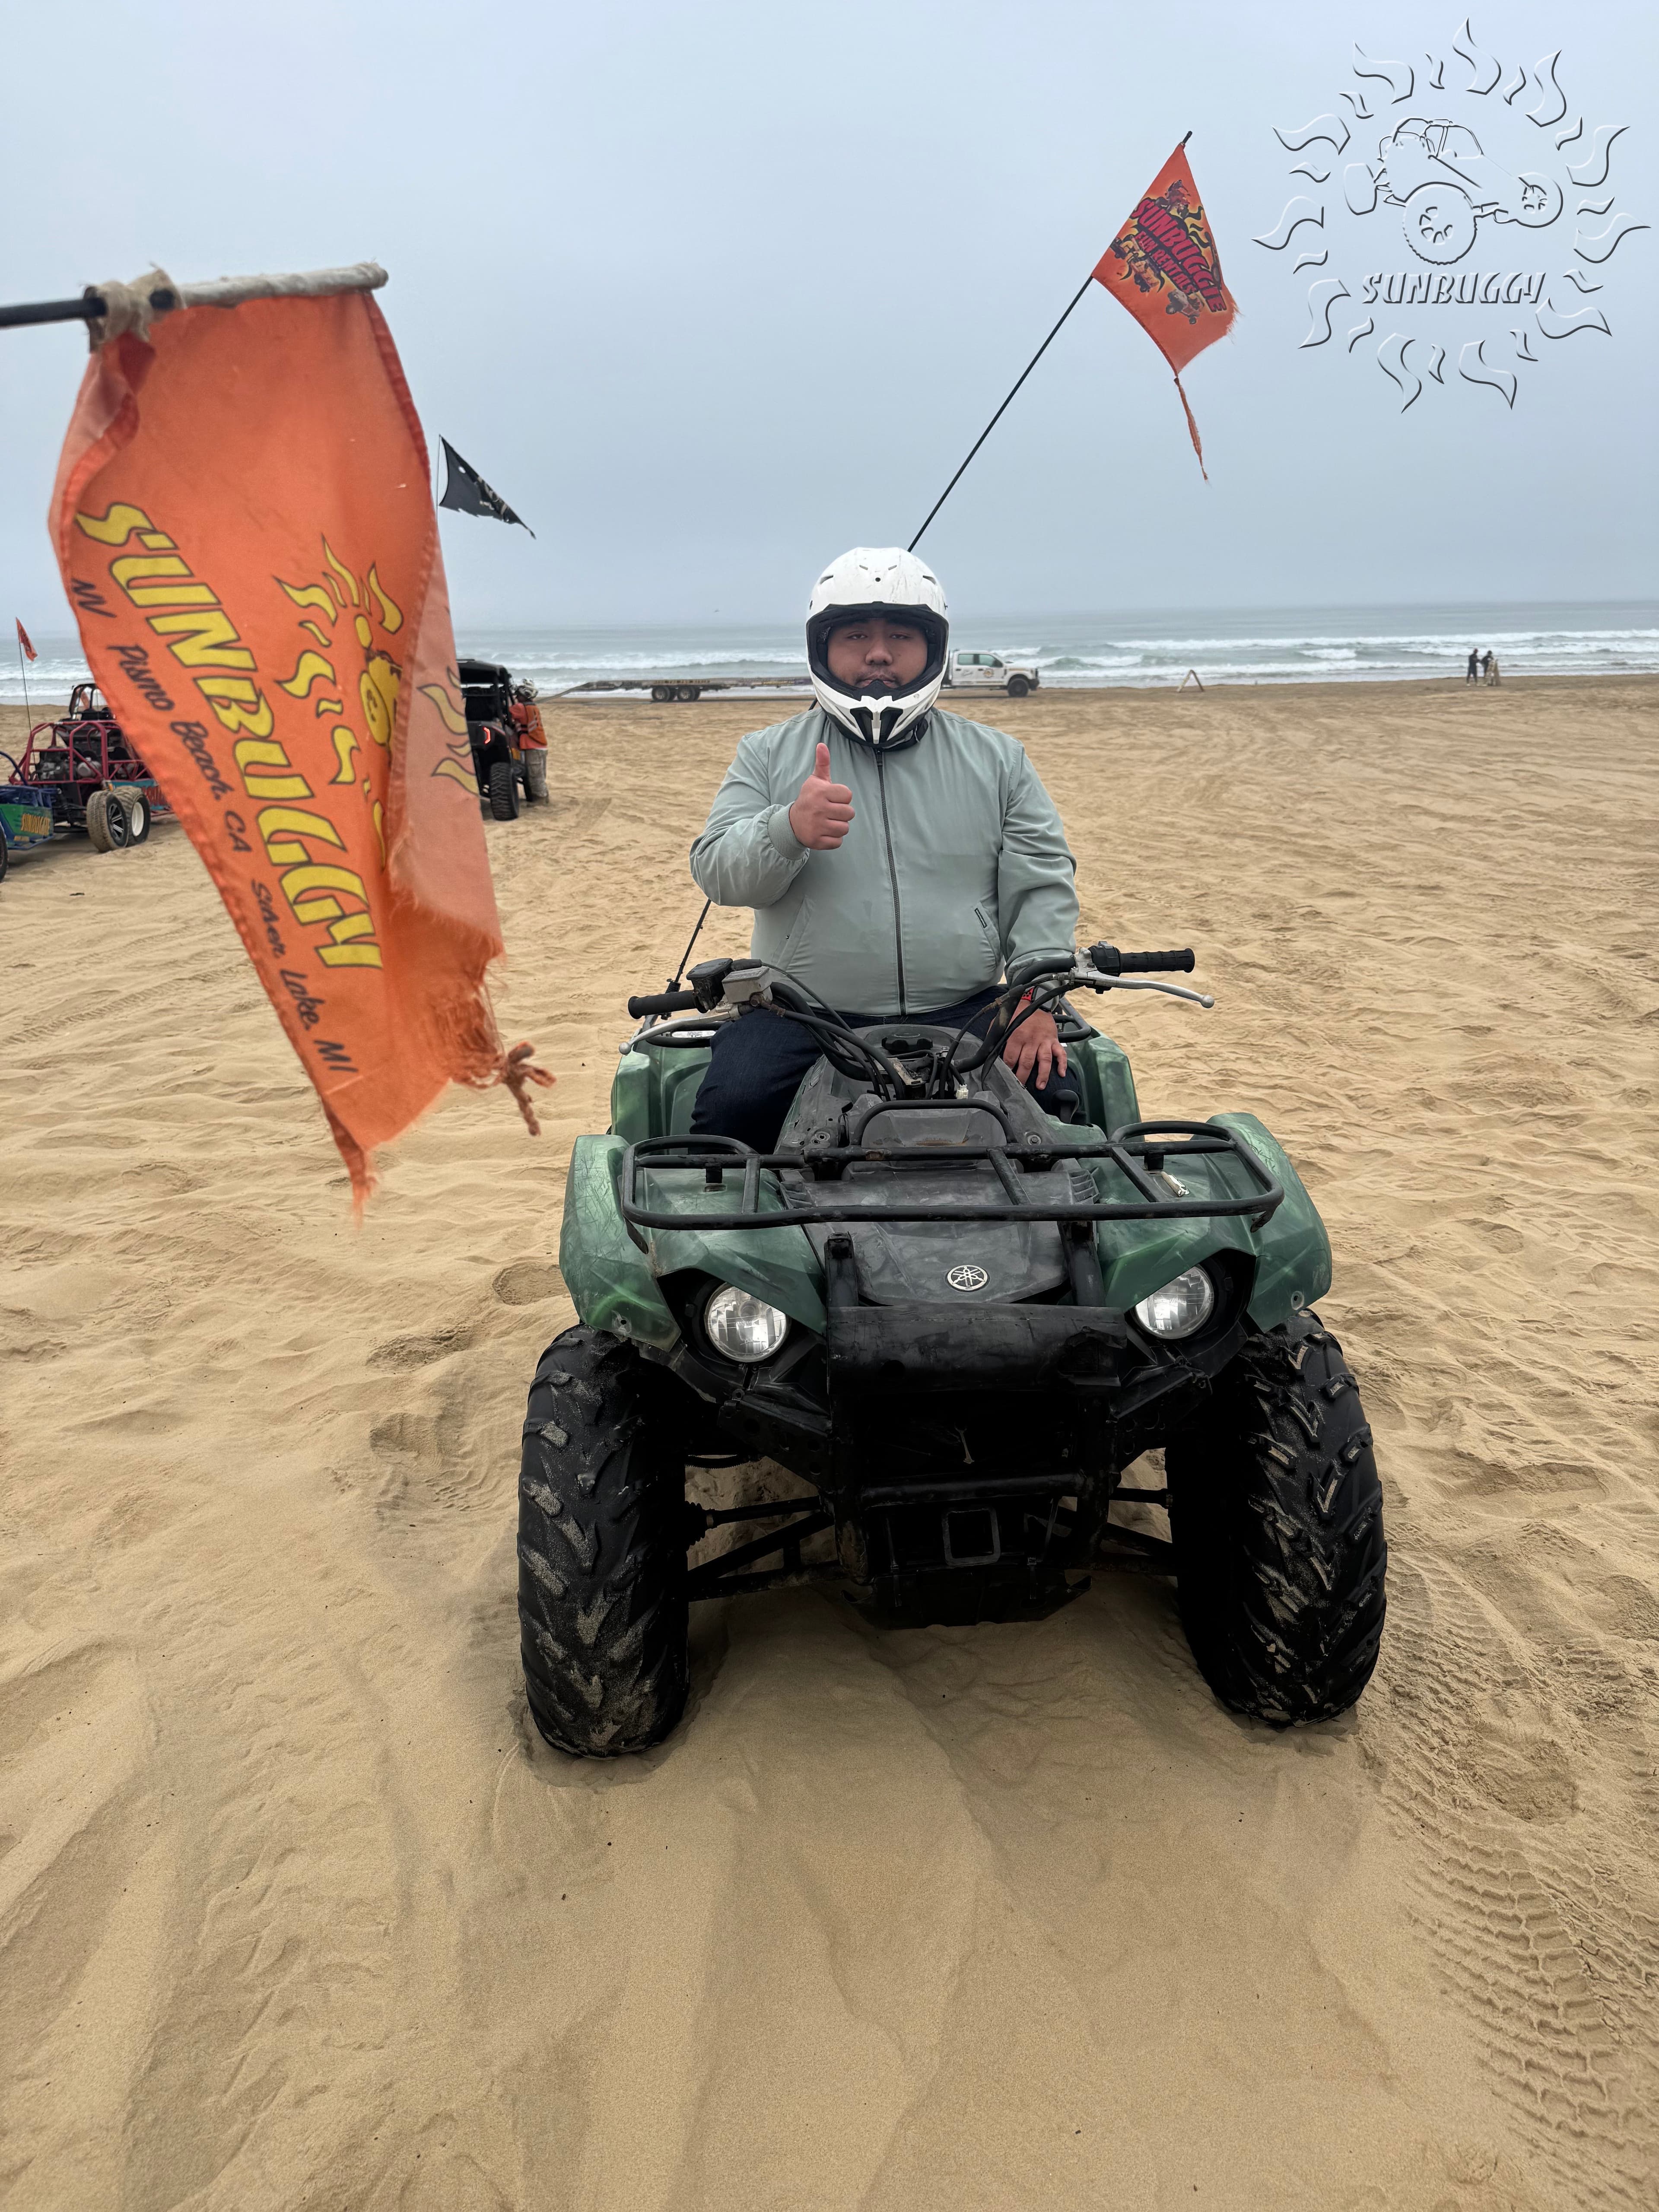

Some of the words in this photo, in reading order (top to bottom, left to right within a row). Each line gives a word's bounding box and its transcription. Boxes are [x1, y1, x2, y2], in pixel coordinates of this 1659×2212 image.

[1129, 198, 1227, 312] SUNBUGGIE
[1134, 230, 1157, 254] FUN
[1152, 248, 1197, 295] RENTALS
[70, 577, 117, 618] NV
[107, 644, 175, 711] Pismo
[225, 810, 252, 852] CA
[251, 879, 286, 959] Silver
[313, 1040, 359, 1072] MI
[73, 502, 383, 969] SUNBUGGY
